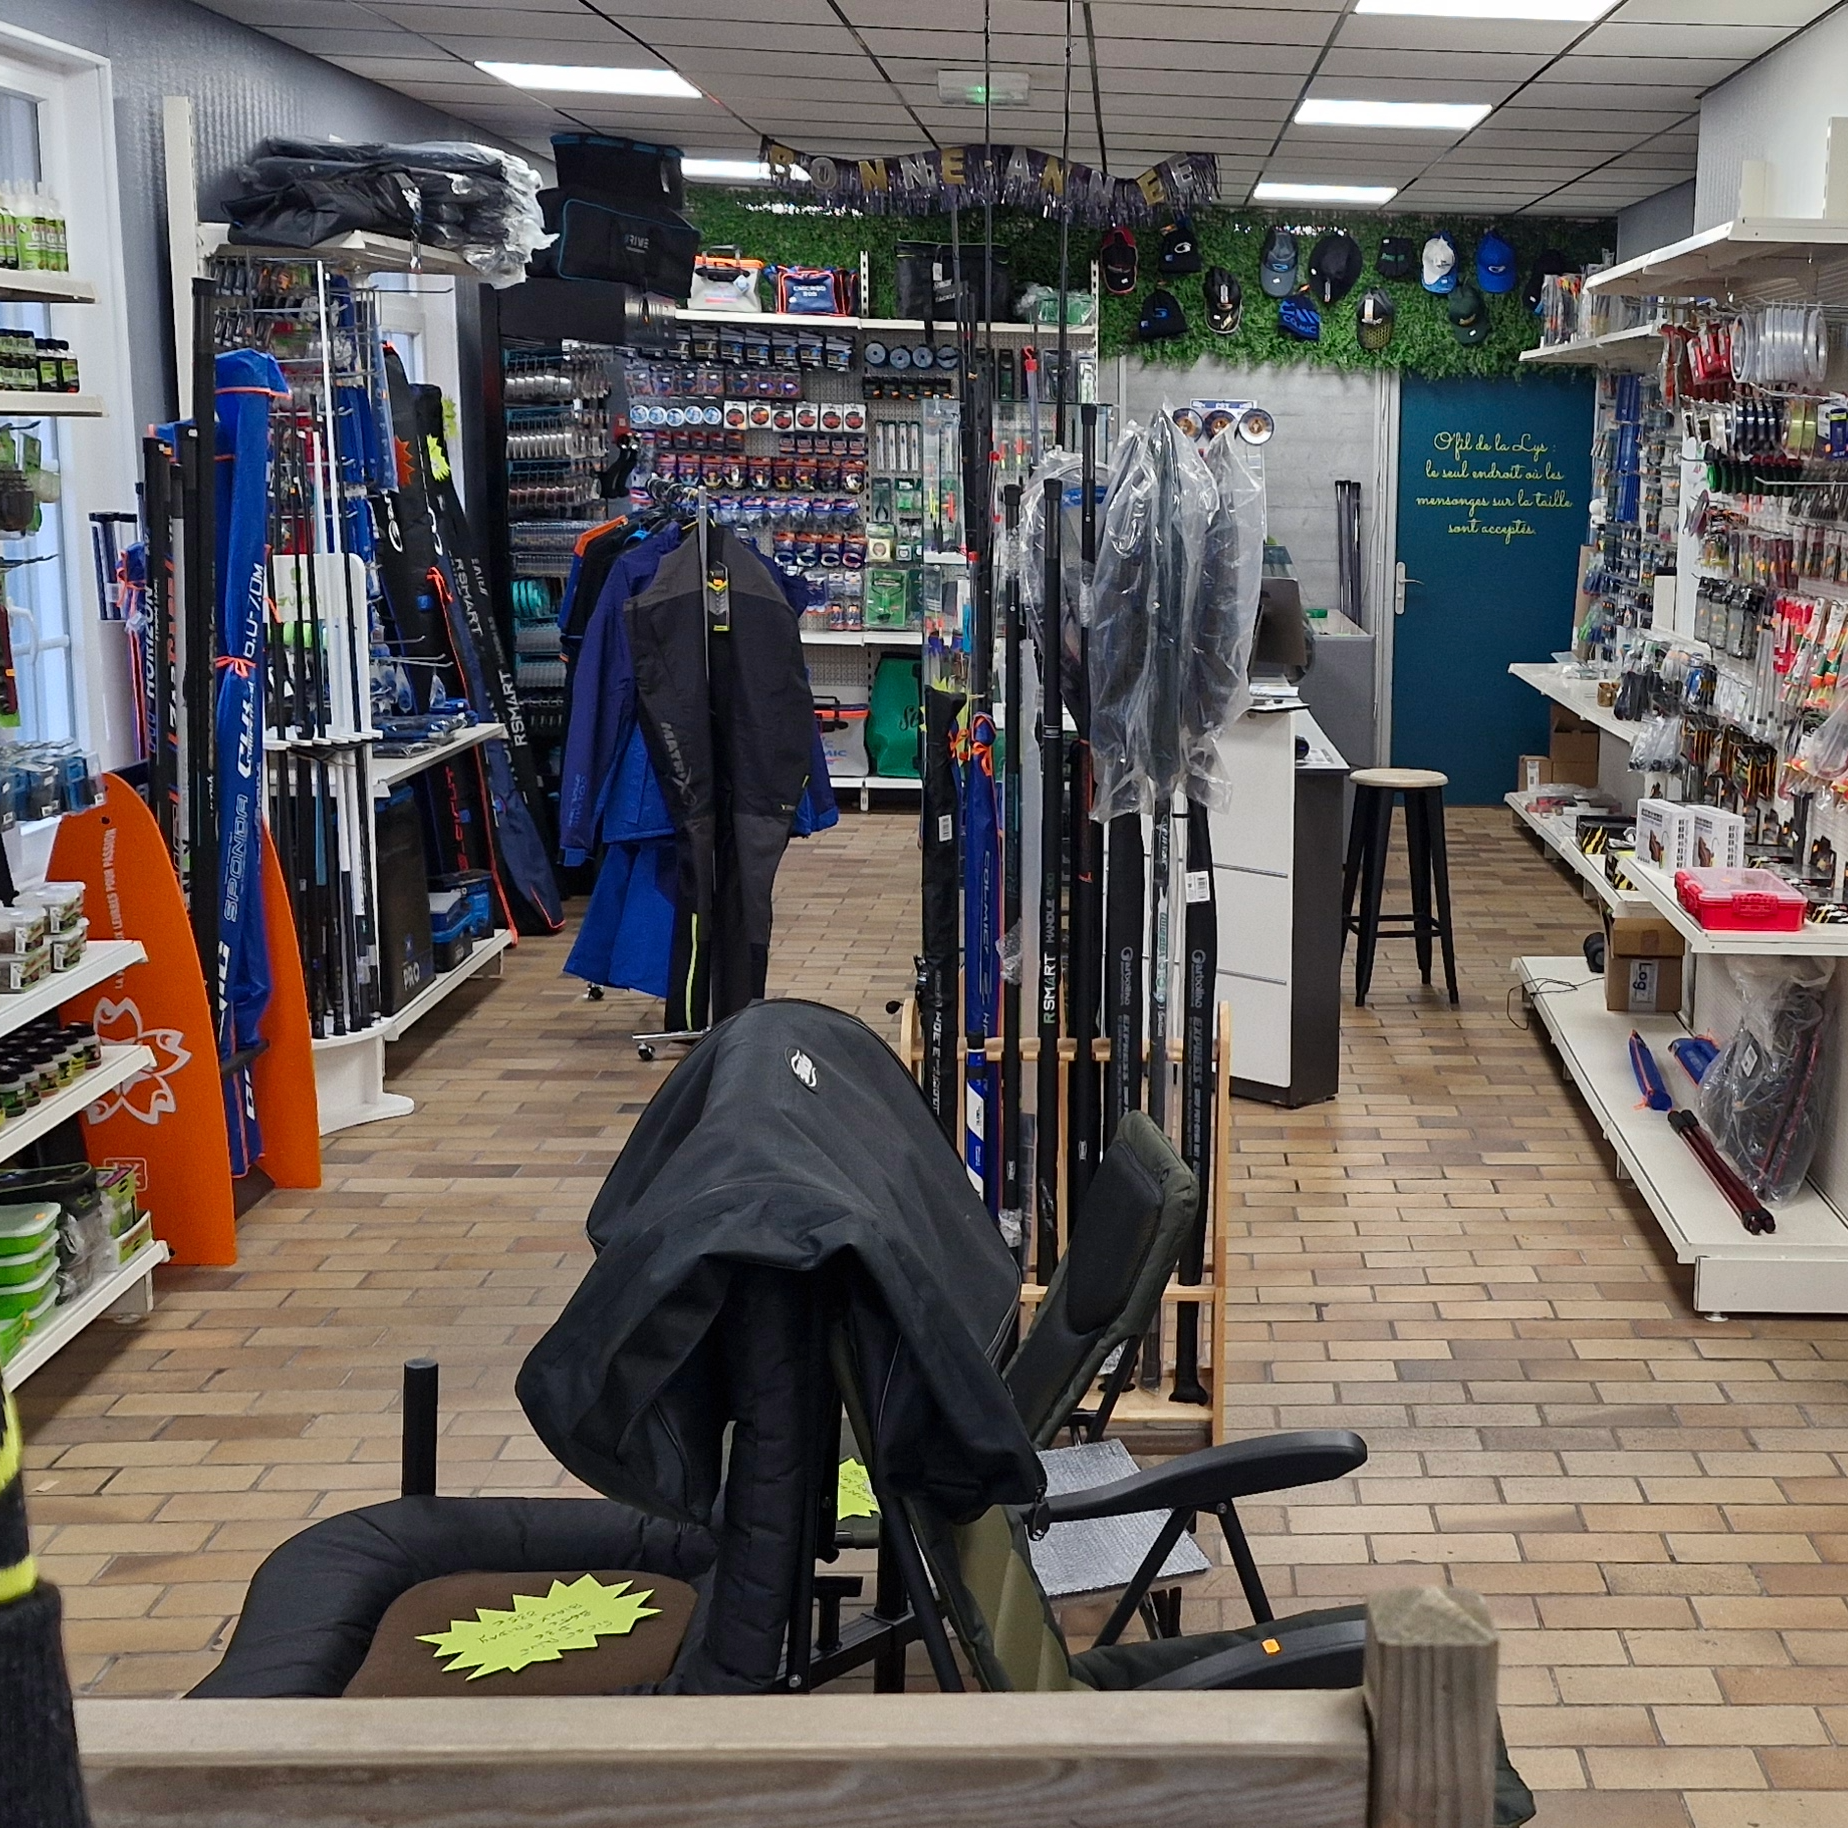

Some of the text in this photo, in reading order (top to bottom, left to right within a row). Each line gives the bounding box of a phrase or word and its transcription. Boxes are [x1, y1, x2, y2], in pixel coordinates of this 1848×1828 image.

[1434, 432, 1472, 461] O'fil
[1475, 434, 1492, 451] de
[1495, 433, 1510, 452] la
[1512, 434, 1549, 462] Lys
[1425, 459, 1440, 479] le
[1442, 460, 1469, 480] seul
[1472, 464, 1525, 480] endroit
[1545, 462, 1564, 480] les
[1416, 489, 1572, 517] mensonges sur la taille
[1448, 518, 1482, 534] sont
[454, 558, 484, 637] RSMART
[144, 584, 155, 700] HORIZON
[498, 670, 528, 747] RSMART
[660, 722, 693, 797] MATRIX
[102, 828, 117, 868] PASSION
[104, 868, 116, 893] POUR
[1046, 899, 1055, 944] HANDLE
[403, 962, 421, 991] PRO
[1043, 953, 1056, 1023] RSMART
[1120, 946, 1134, 1006] Garbolino
[1192, 949, 1206, 1009] Garbolino
[1632, 962, 1653, 991] Log
